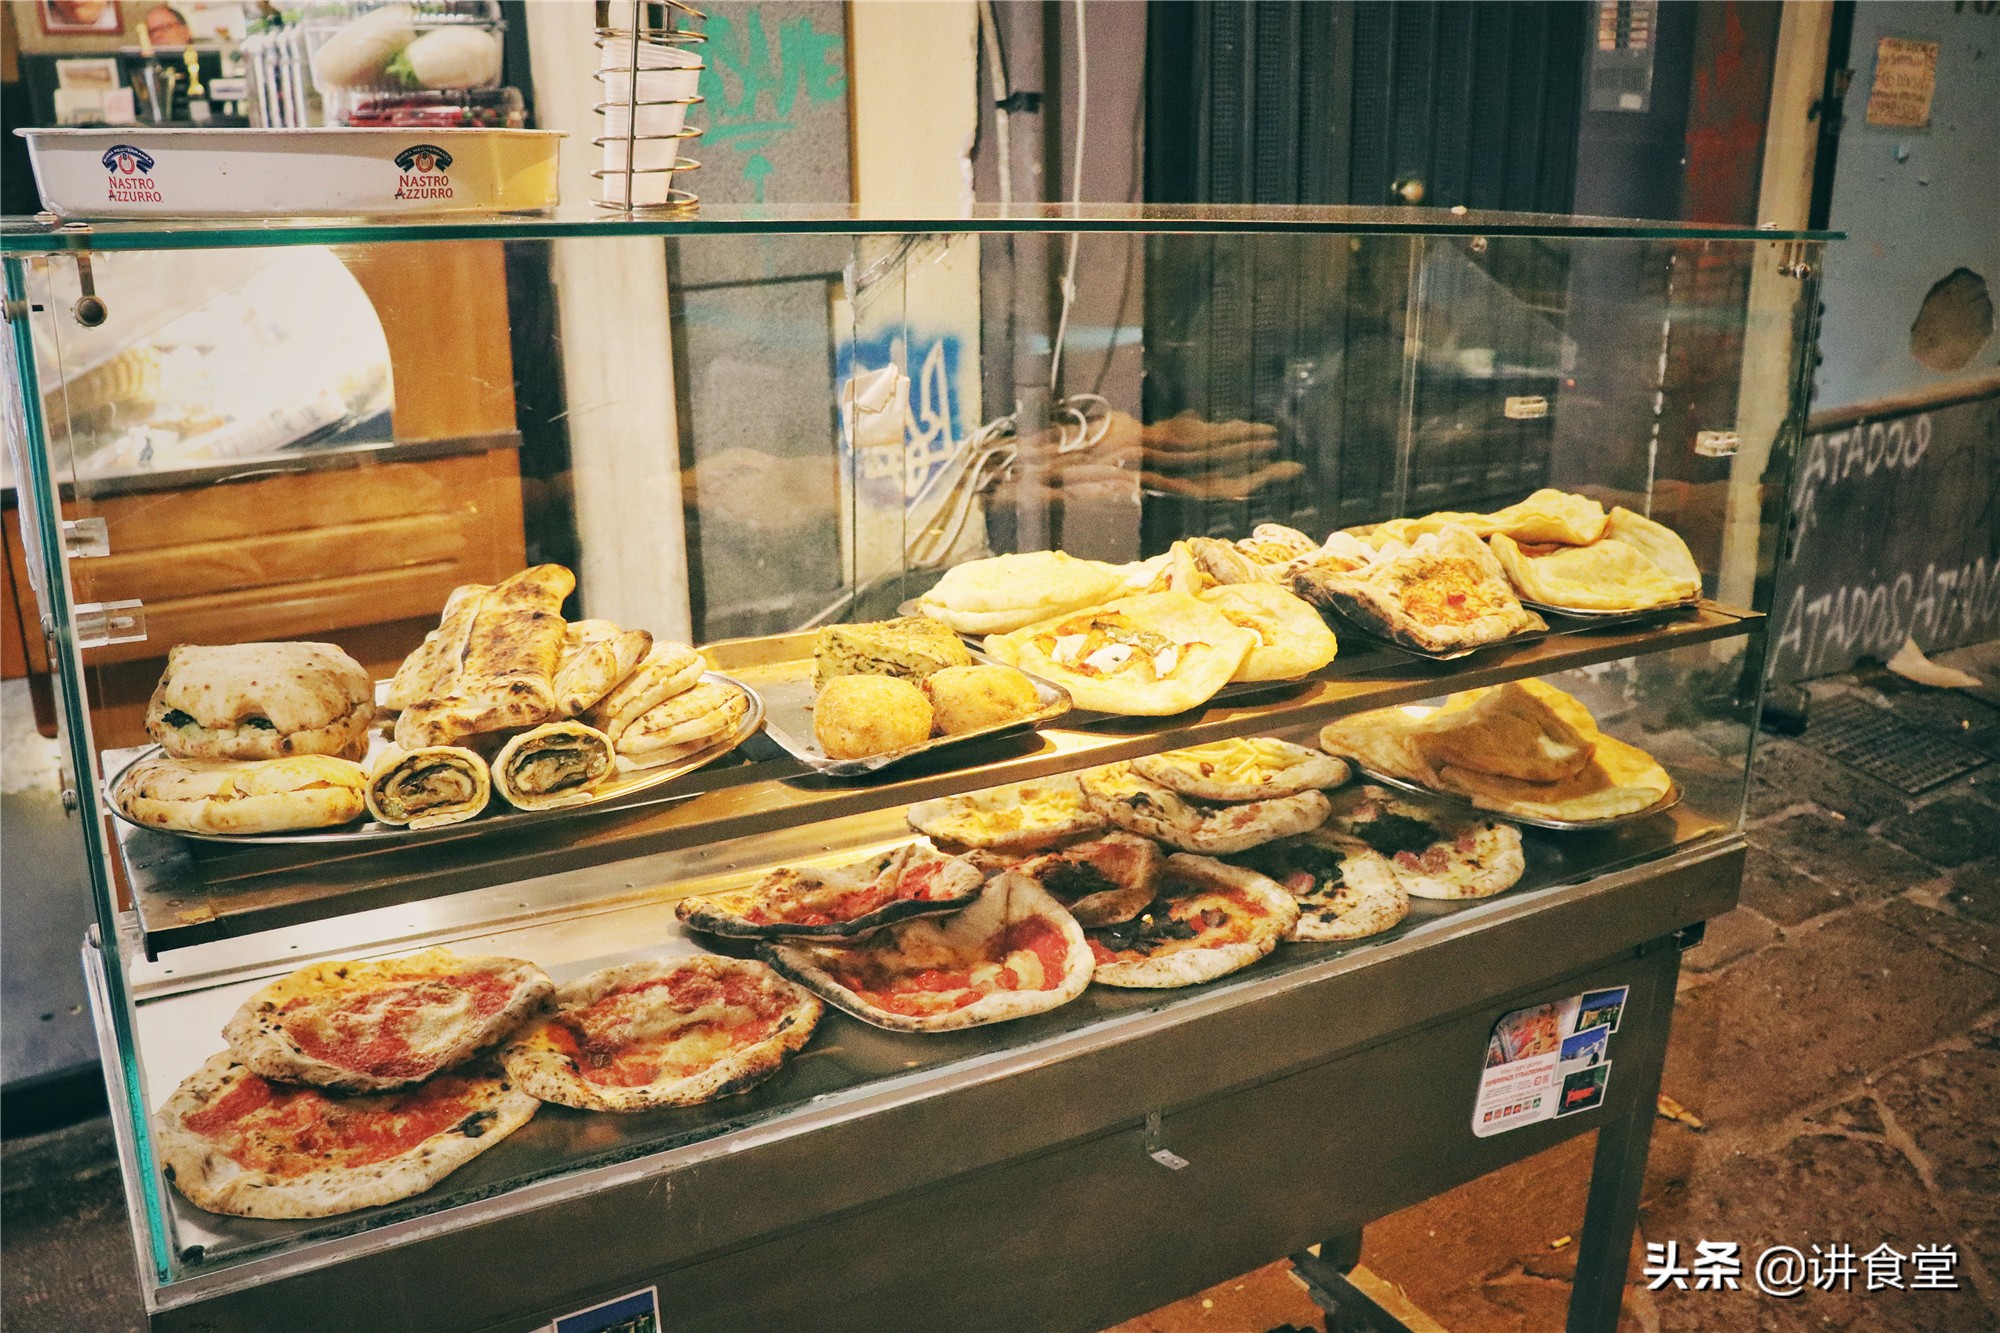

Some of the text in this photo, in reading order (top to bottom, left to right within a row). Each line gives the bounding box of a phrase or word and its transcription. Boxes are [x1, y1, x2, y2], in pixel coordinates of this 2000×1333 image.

[108, 176, 155, 190] NASTRO
[400, 175, 449, 187] NASTRO
[108, 190, 162, 203] AZZURRO
[395, 188, 453, 200] AZZURRO
